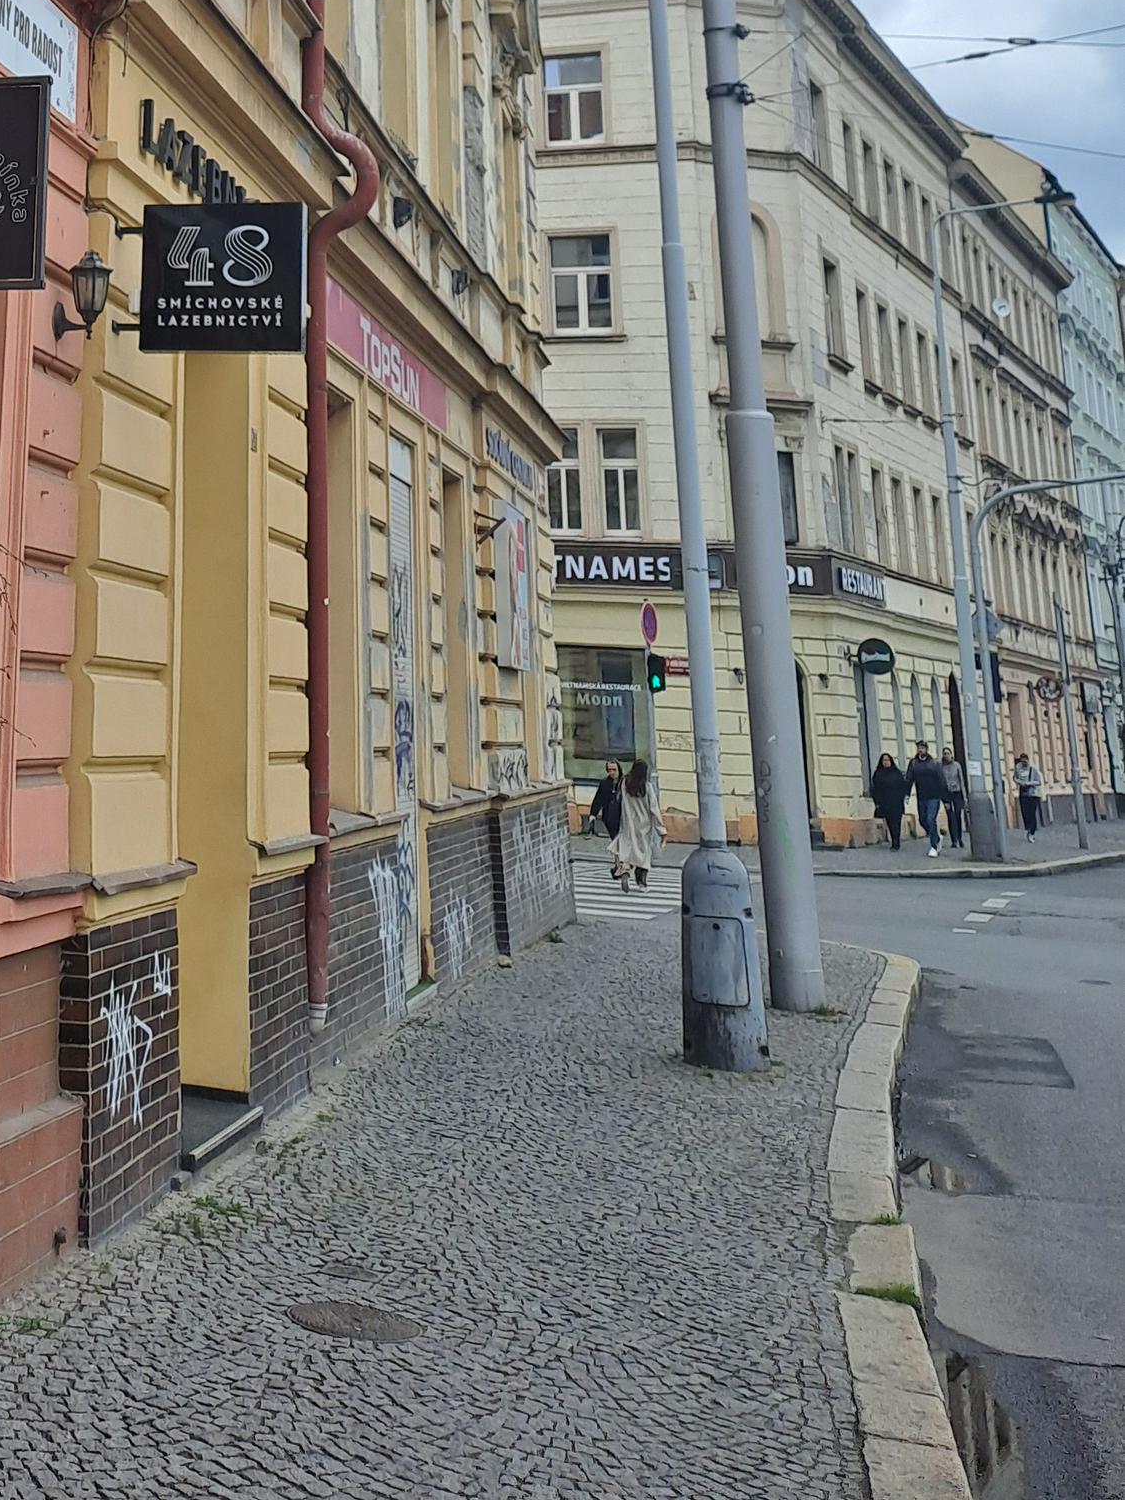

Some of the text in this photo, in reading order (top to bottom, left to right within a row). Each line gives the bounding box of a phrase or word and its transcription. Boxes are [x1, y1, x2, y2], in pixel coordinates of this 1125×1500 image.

[13, 5, 30, 47] PRO
[31, 23, 64, 78] RADOST
[166, 224, 274, 287] 48
[157, 294, 283, 310] SMÍCHOVSKÉ
[157, 314, 283, 327] LAZEBNICTVÍ
[841, 567, 887, 600] RESTAURANT
[576, 692, 622, 706] Moon
